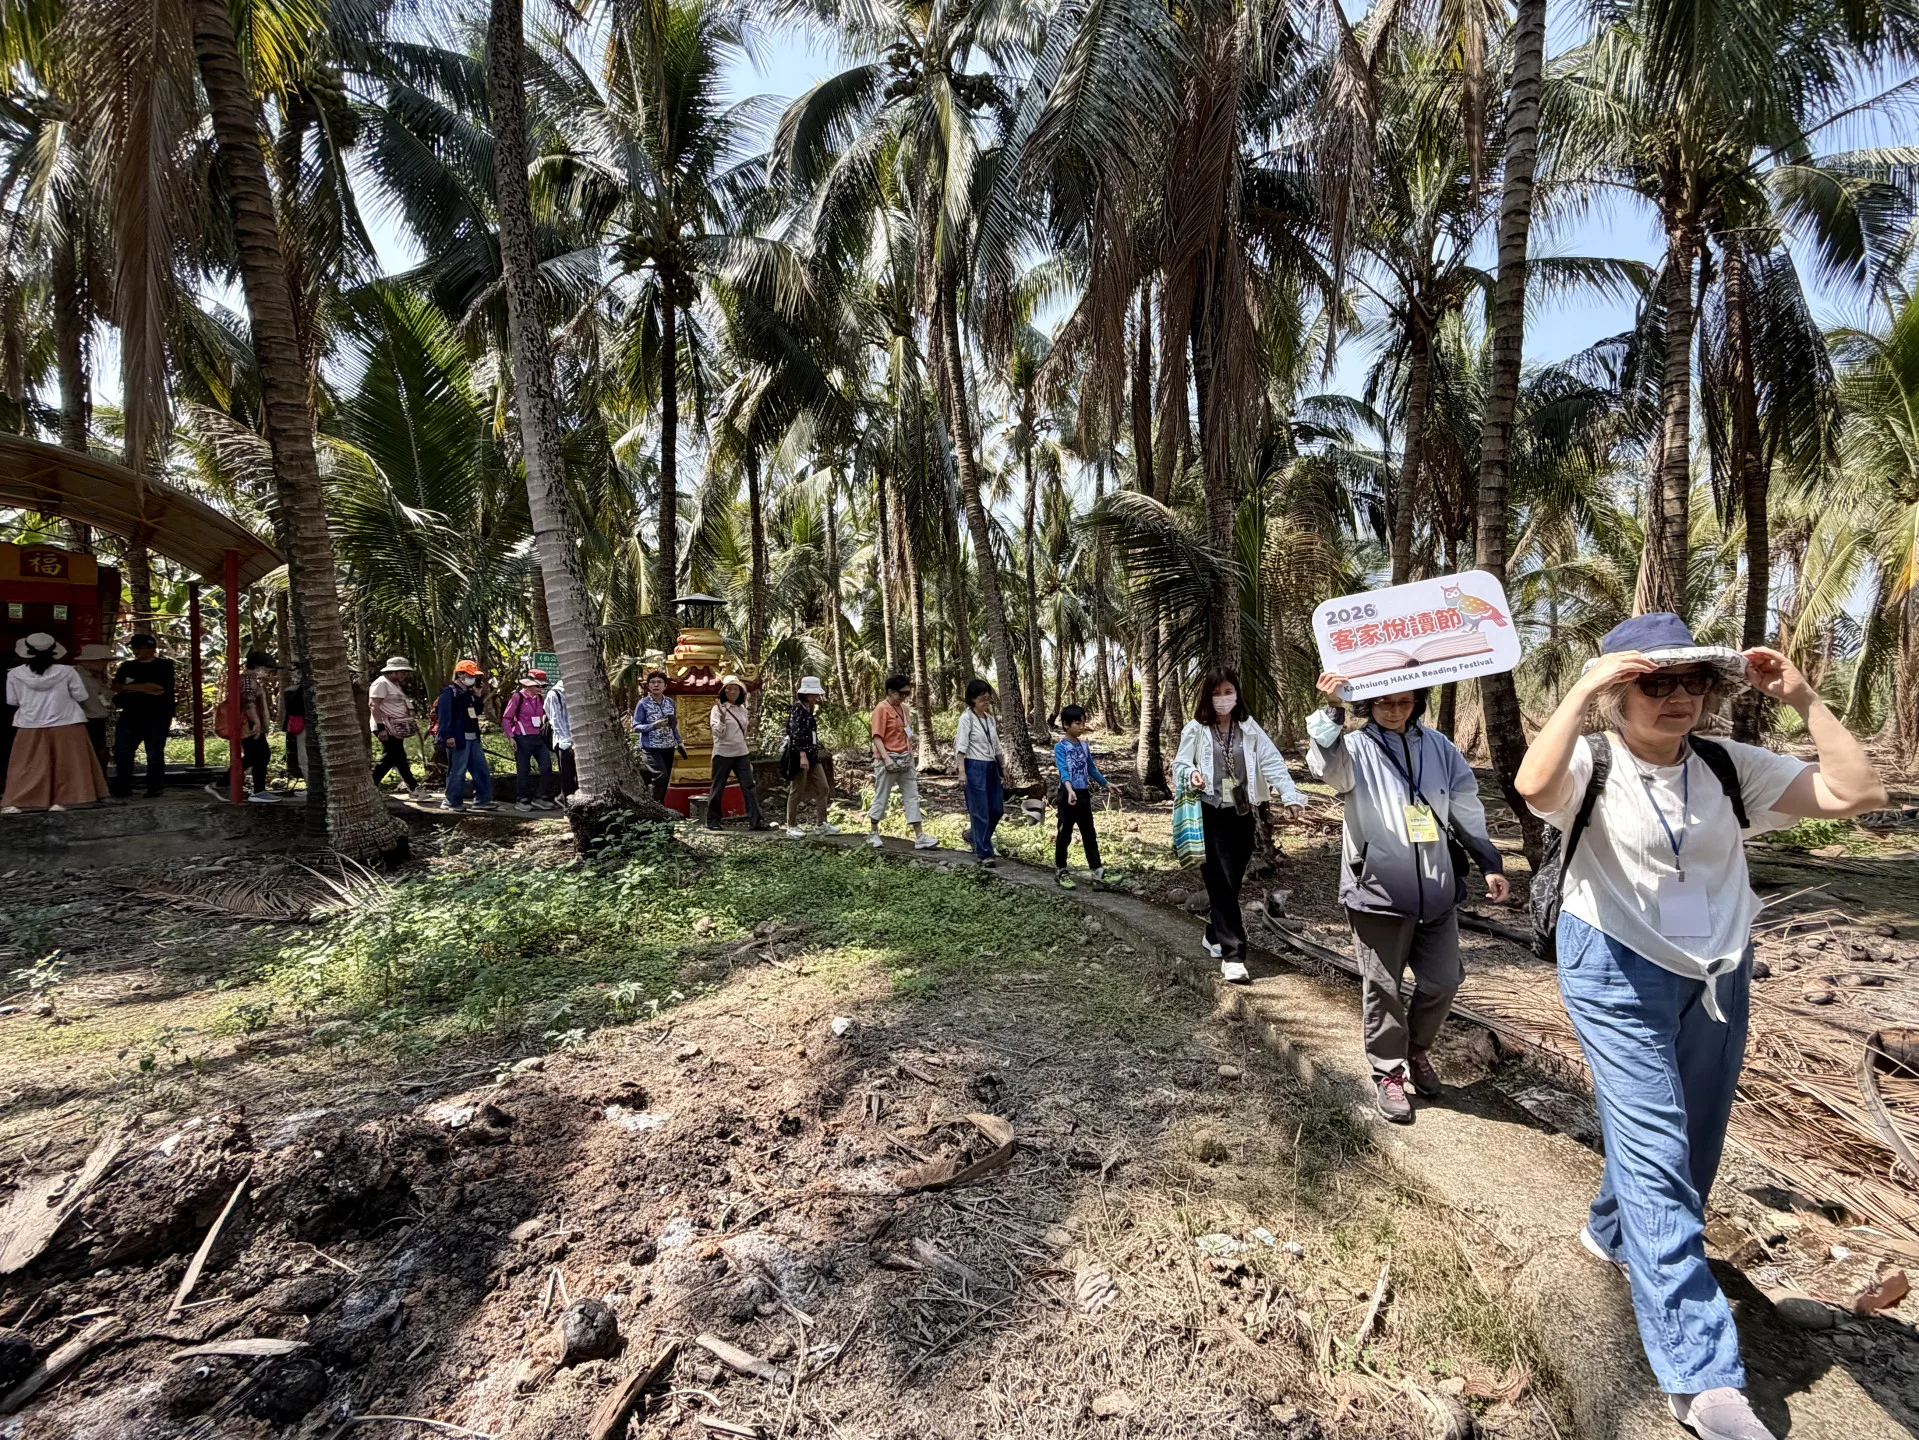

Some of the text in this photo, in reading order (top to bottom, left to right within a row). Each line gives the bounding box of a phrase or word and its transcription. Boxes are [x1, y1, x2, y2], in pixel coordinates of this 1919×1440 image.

[29, 552, 62, 576] 福
[1325, 604, 1376, 625] 2026
[1329, 607, 1463, 652] 客家悅讀節
[1343, 658, 1494, 693] Kaohsiung HAKKA Reading Festival
